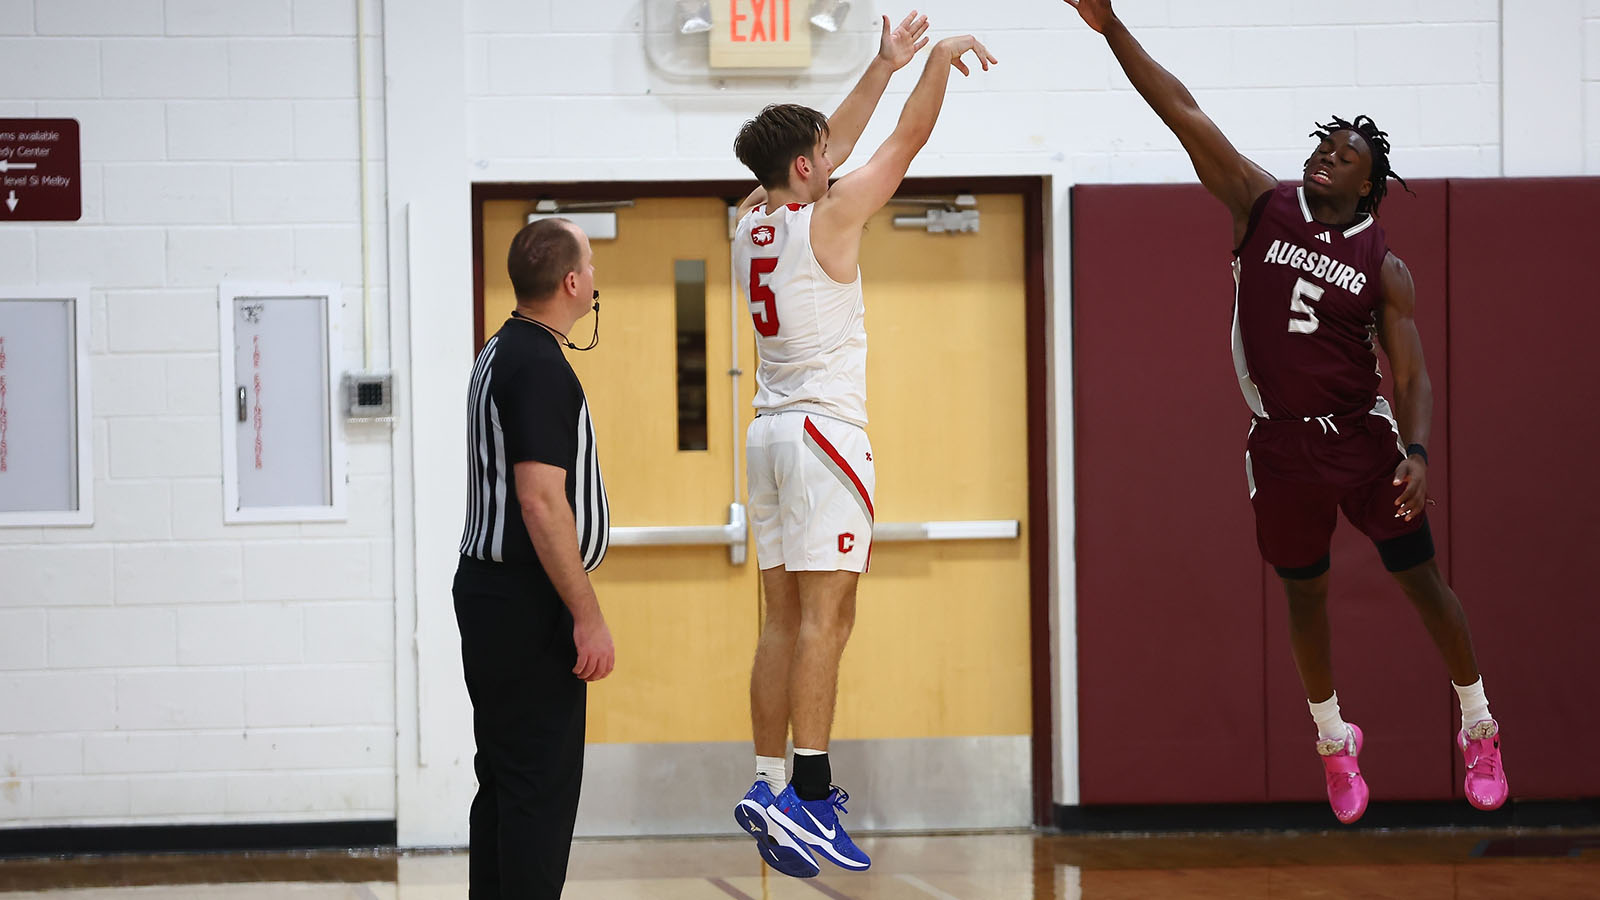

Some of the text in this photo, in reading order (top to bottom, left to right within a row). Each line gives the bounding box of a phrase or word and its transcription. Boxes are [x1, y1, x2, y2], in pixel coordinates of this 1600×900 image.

[730, 0, 790, 42] EXIT
[18, 130, 60, 141] available
[0, 146, 51, 159] dy Center
[4, 176, 27, 186] level
[41, 176, 71, 188] Melby
[1263, 239, 1367, 296] AUGSBURG
[749, 257, 781, 338] 5
[1288, 277, 1325, 335] 5
[838, 532, 855, 554] C
